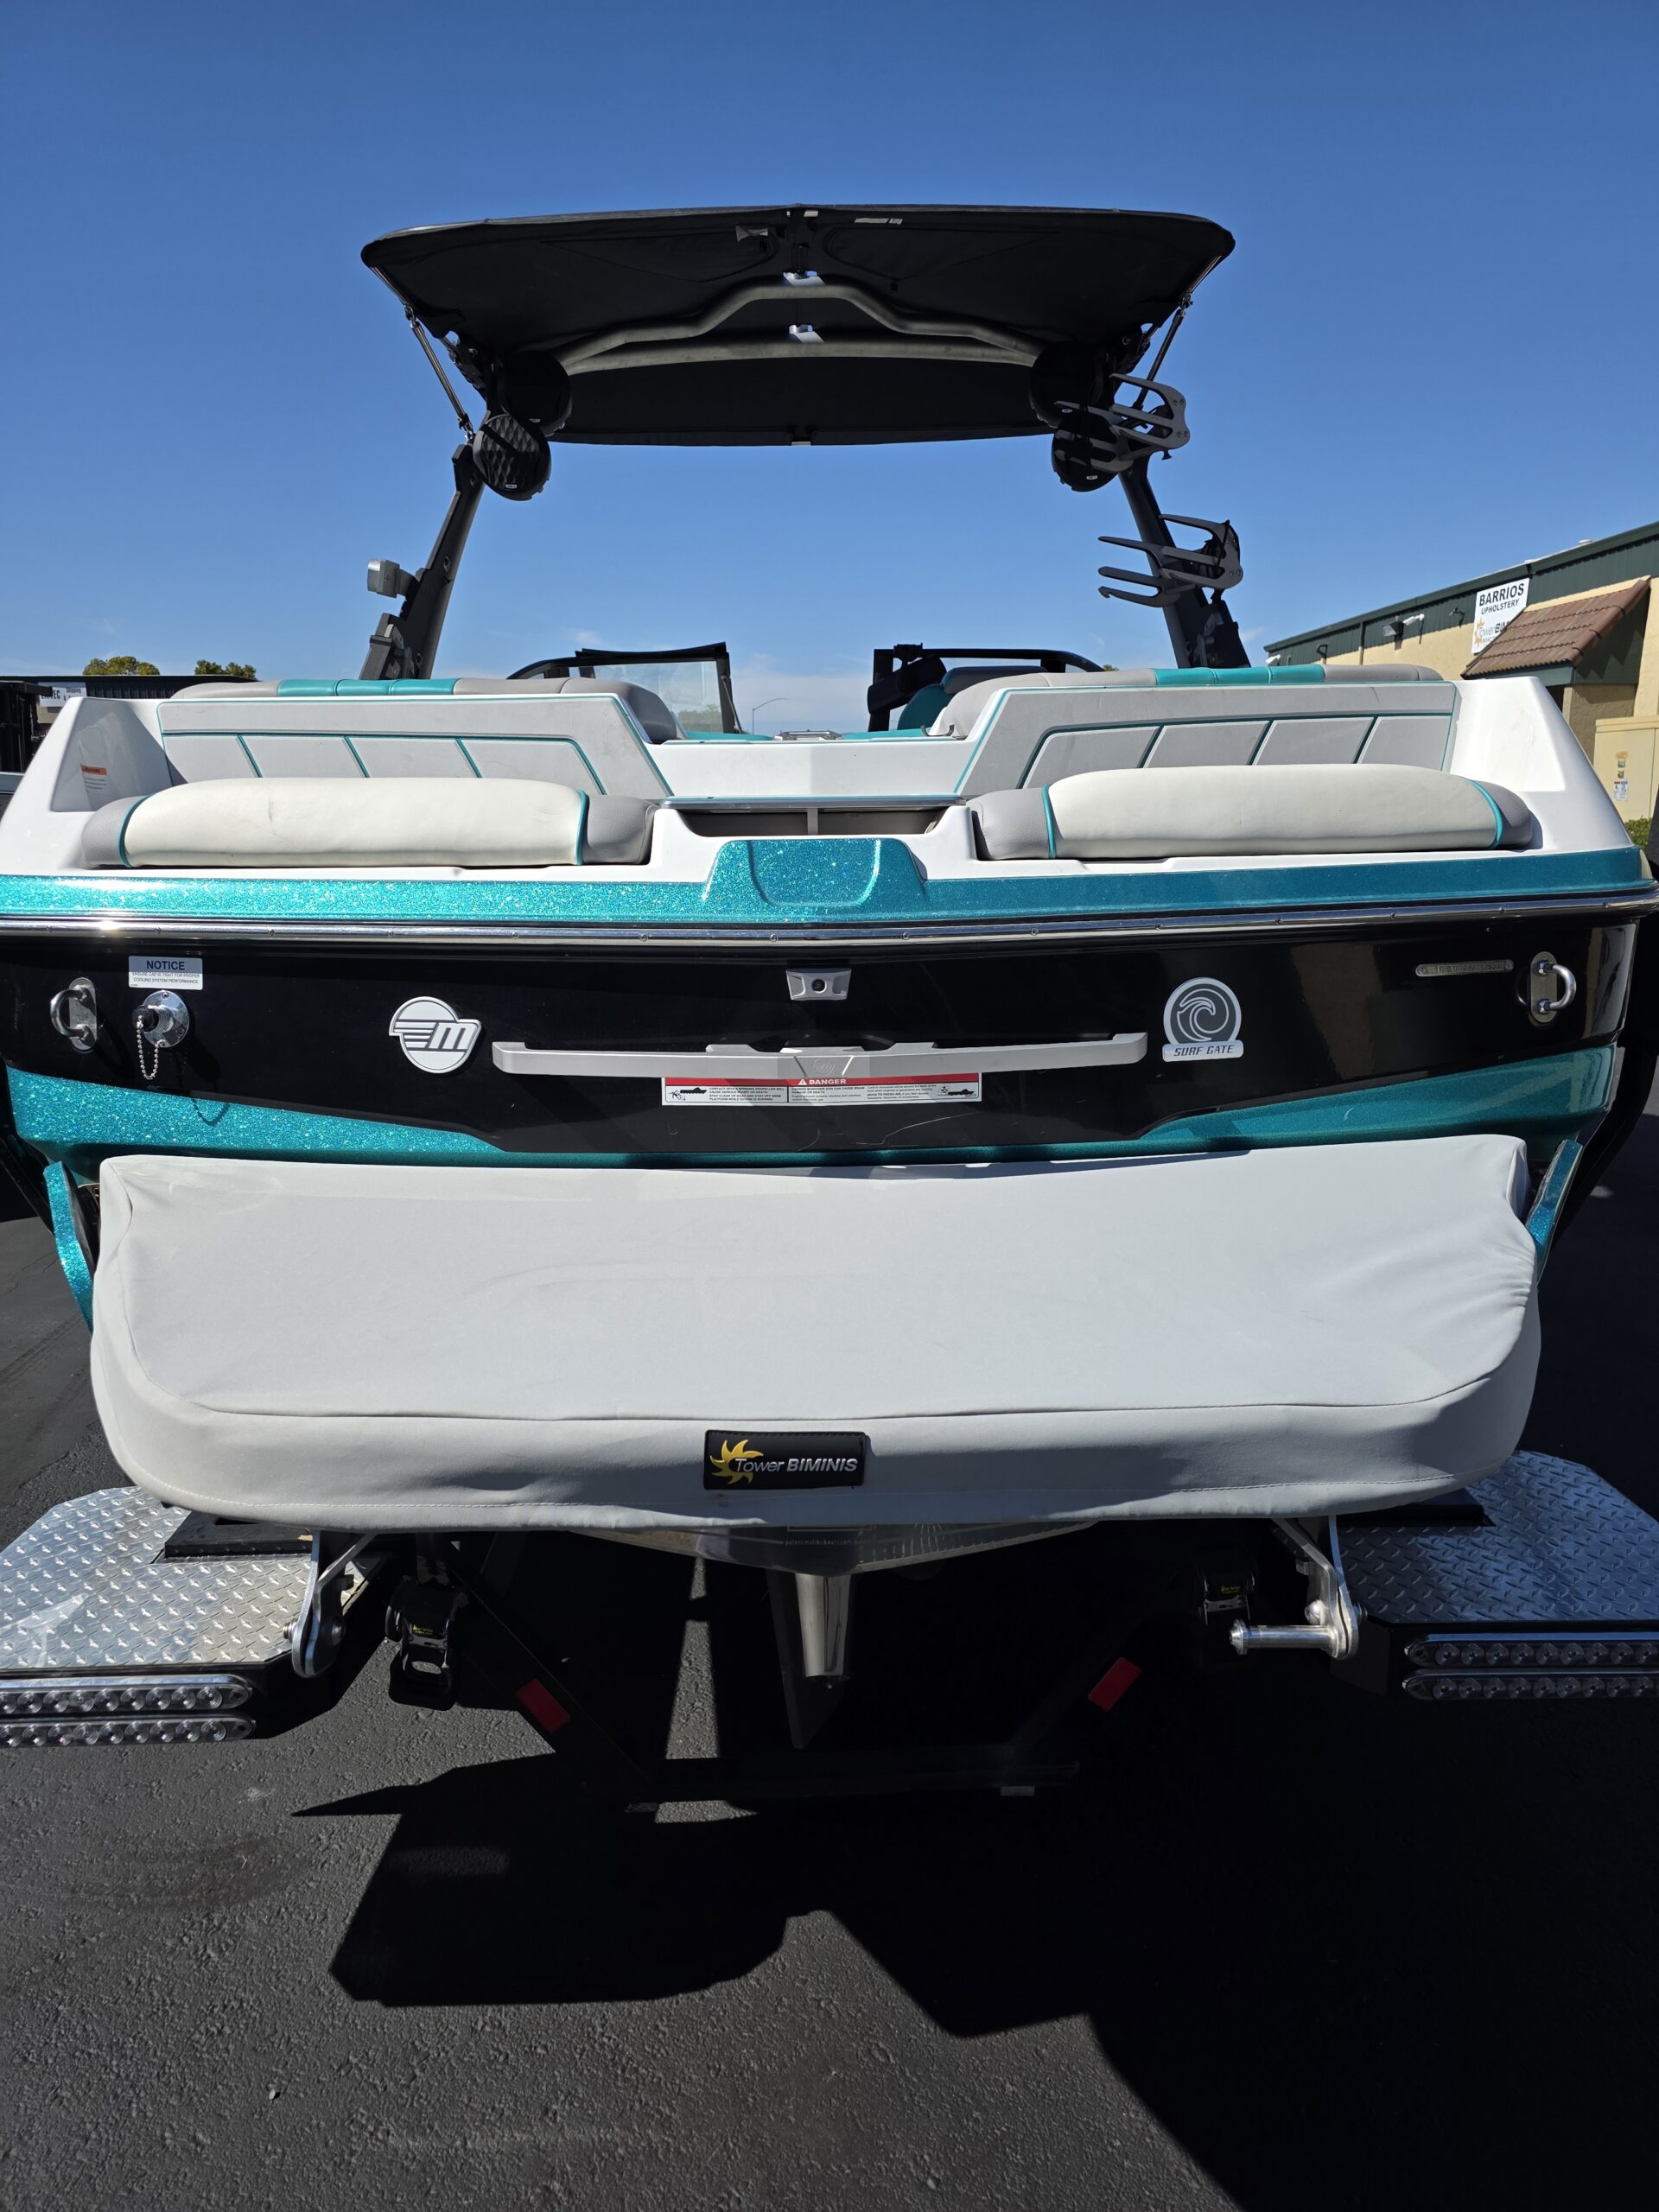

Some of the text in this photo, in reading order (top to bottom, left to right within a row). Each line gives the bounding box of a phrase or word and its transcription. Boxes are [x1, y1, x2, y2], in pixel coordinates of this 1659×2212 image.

[1479, 583, 1524, 606] BARRIOS
[1481, 599, 1519, 614] UPHOLSTERY
[146, 960, 185, 970] NOTICE
[1173, 1045, 1236, 1057] SURF GATE
[734, 1458, 858, 1472] Tower BIMINIS
